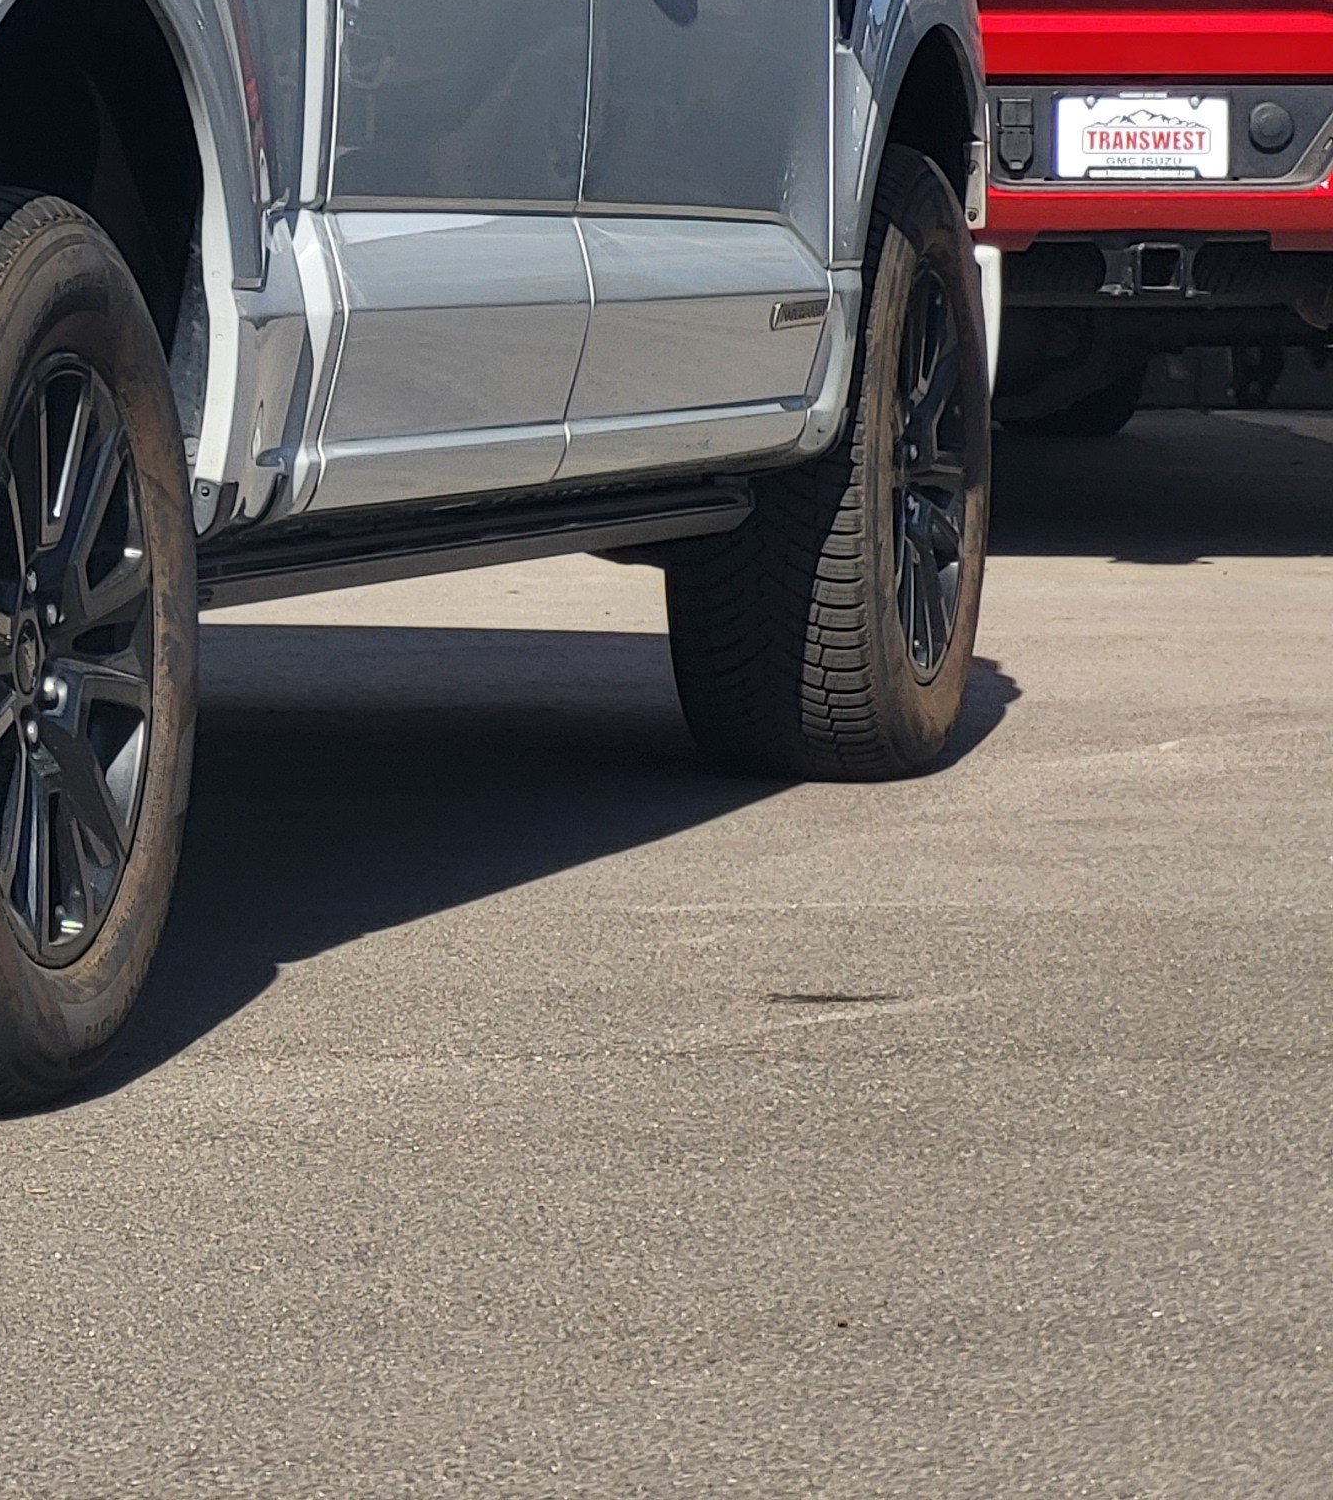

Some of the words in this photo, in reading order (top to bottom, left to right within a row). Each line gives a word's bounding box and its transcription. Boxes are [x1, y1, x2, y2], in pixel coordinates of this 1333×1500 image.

[1086, 130, 1207, 151] TRANSWEST
[1105, 156, 1137, 165] GMC
[1141, 156, 1183, 165] ISUZU
